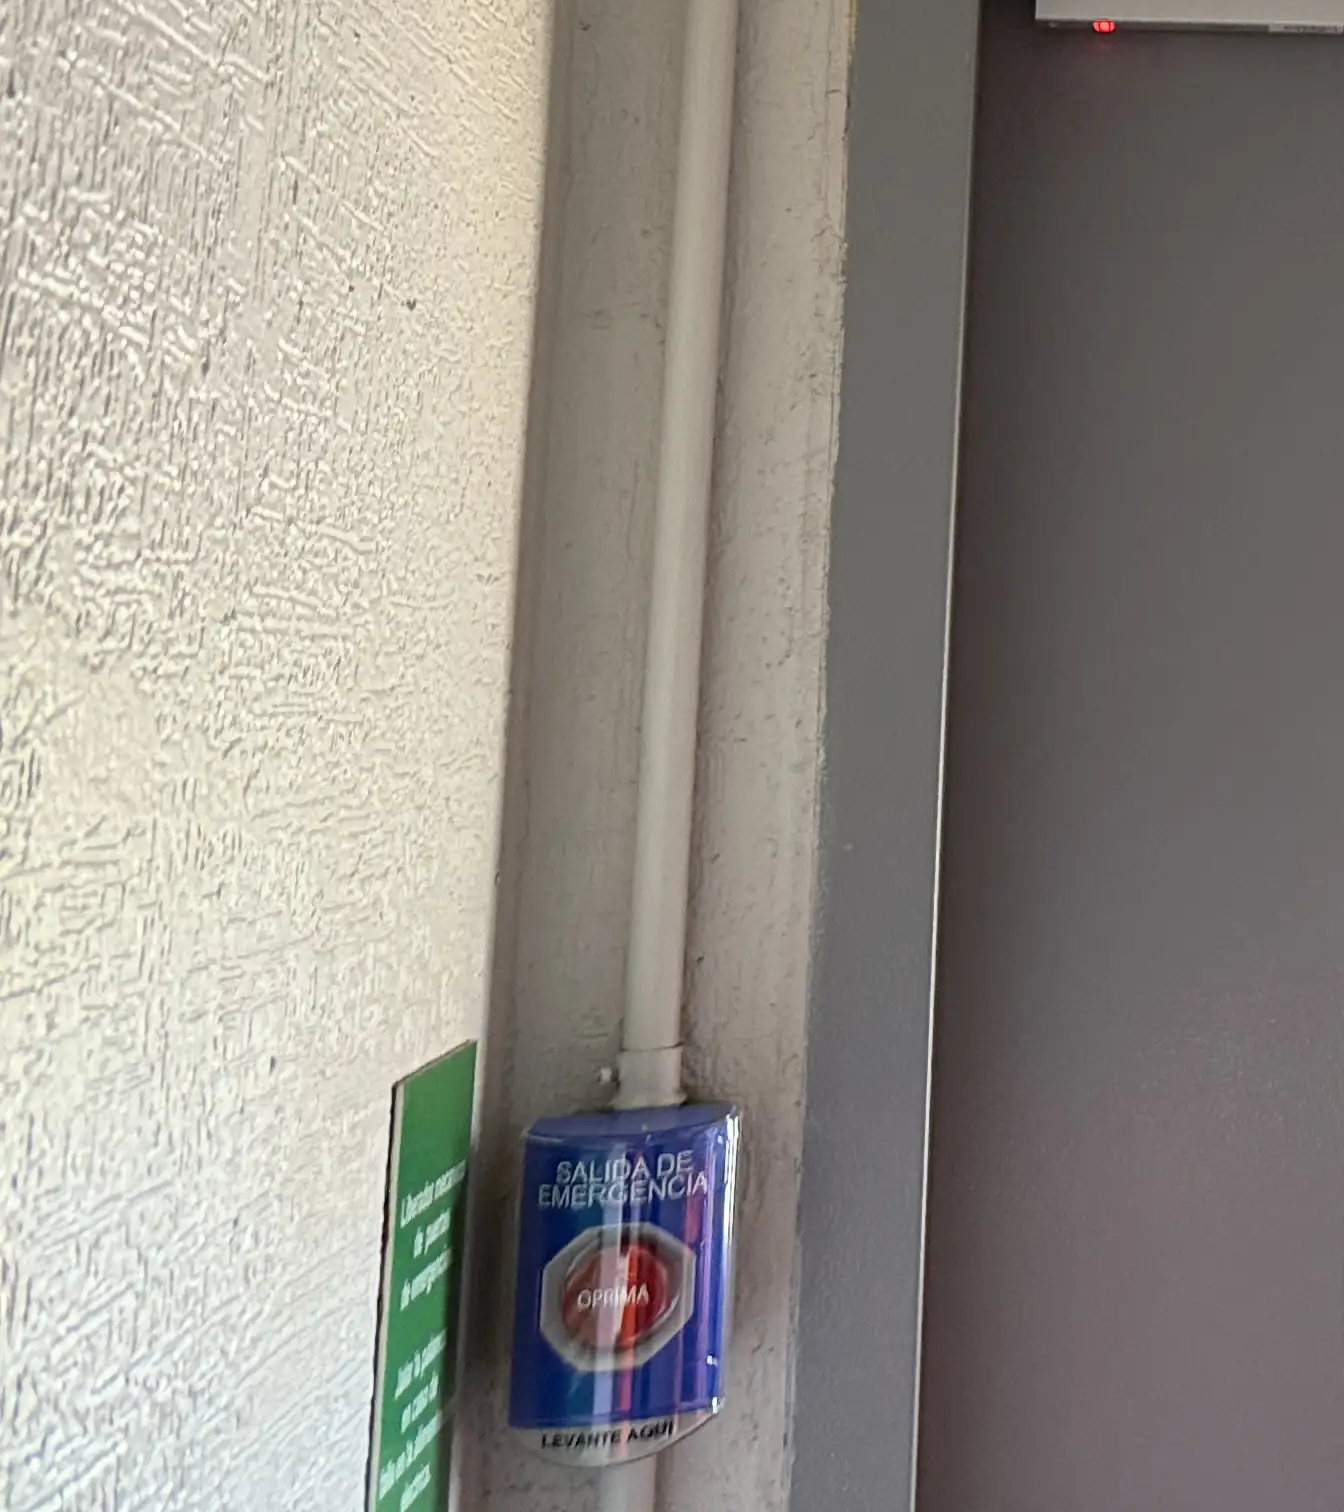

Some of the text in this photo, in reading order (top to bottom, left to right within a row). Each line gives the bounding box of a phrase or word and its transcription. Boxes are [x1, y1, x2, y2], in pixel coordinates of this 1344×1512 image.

[556, 1150, 694, 1185] SALIDA DE
[537, 1171, 708, 1209] EMERGENCIA
[576, 1283, 649, 1309] OPRIMA
[541, 1431, 621, 1448] LEVANTE
